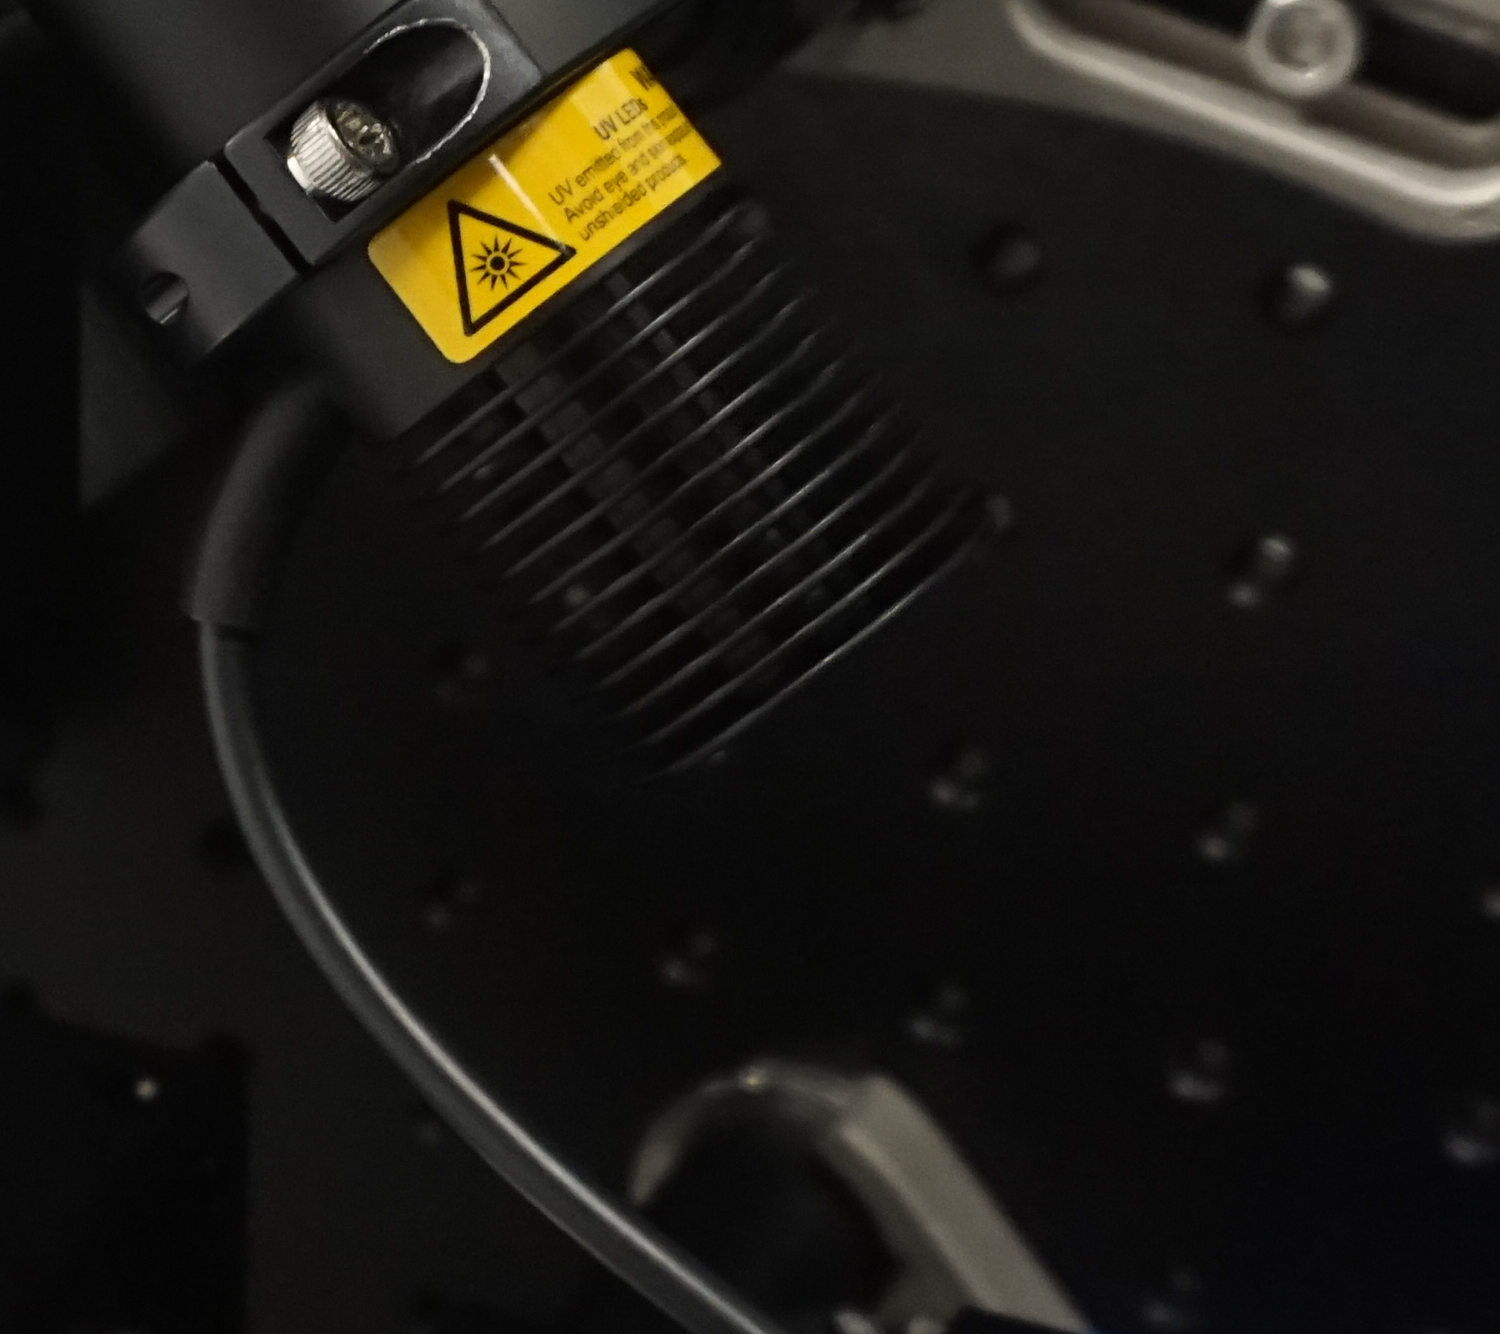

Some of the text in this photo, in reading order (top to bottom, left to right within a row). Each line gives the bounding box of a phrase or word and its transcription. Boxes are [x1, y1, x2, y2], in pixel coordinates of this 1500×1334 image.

[594, 117, 619, 141] UV
[548, 180, 575, 205] UV
[563, 189, 604, 223] Avoid
[602, 170, 629, 195] eye
